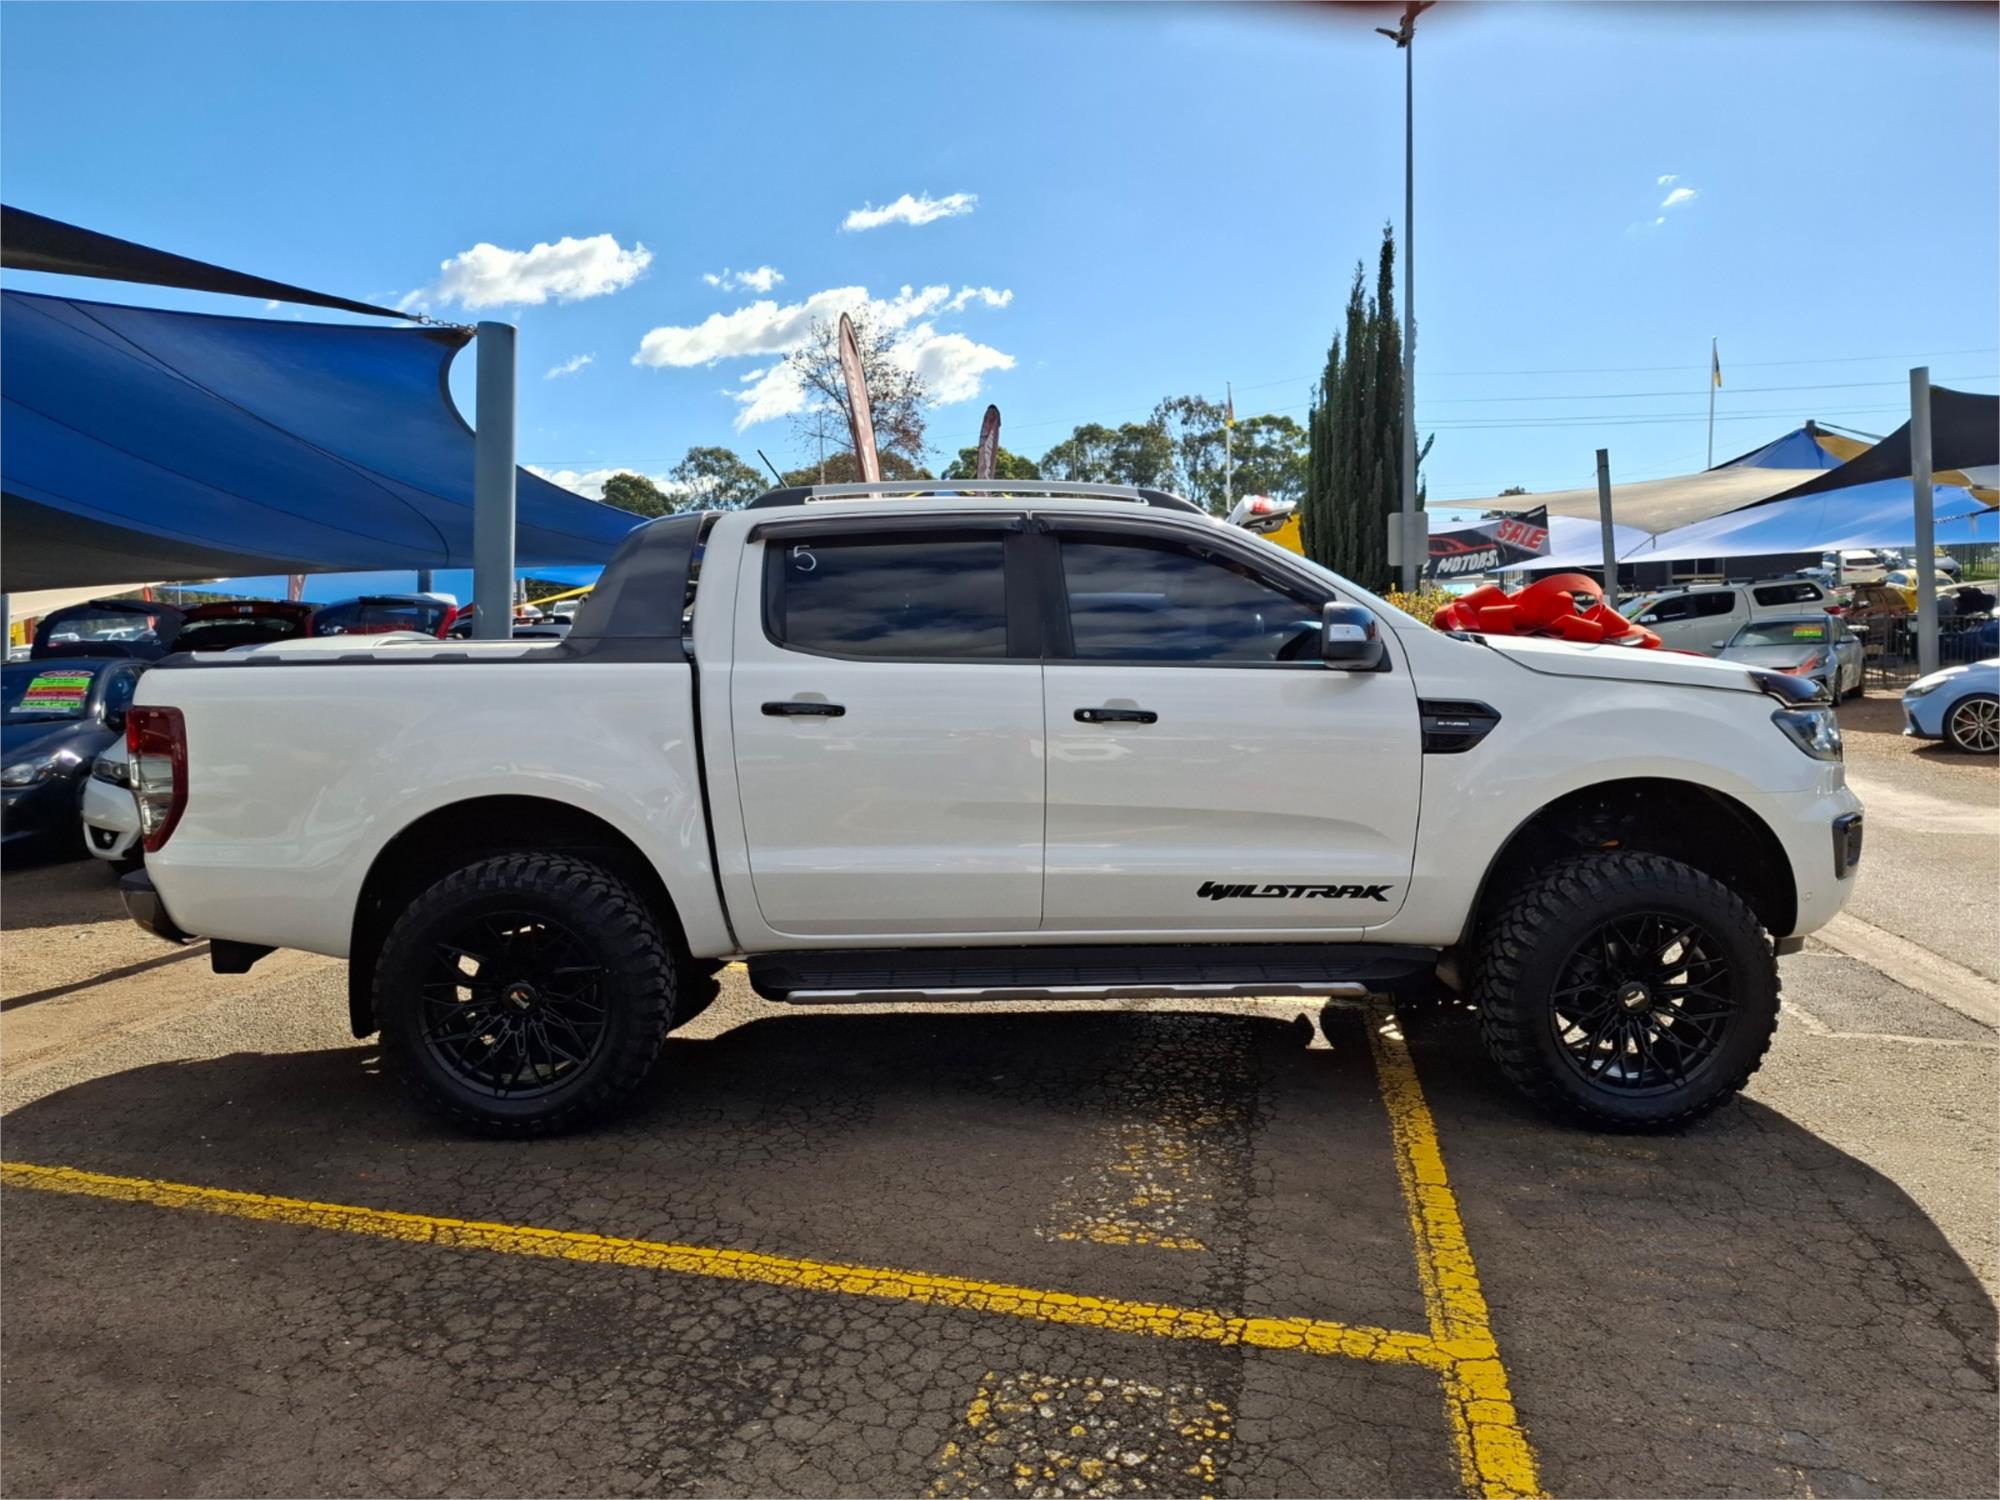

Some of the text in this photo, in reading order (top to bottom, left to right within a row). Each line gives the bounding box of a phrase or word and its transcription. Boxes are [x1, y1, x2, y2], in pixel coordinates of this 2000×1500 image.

[1497, 518, 1549, 551] SALE
[793, 544, 816, 571] 5
[1437, 550, 1497, 573] MOTORS
[1196, 881, 1395, 902] WILDTRAK
